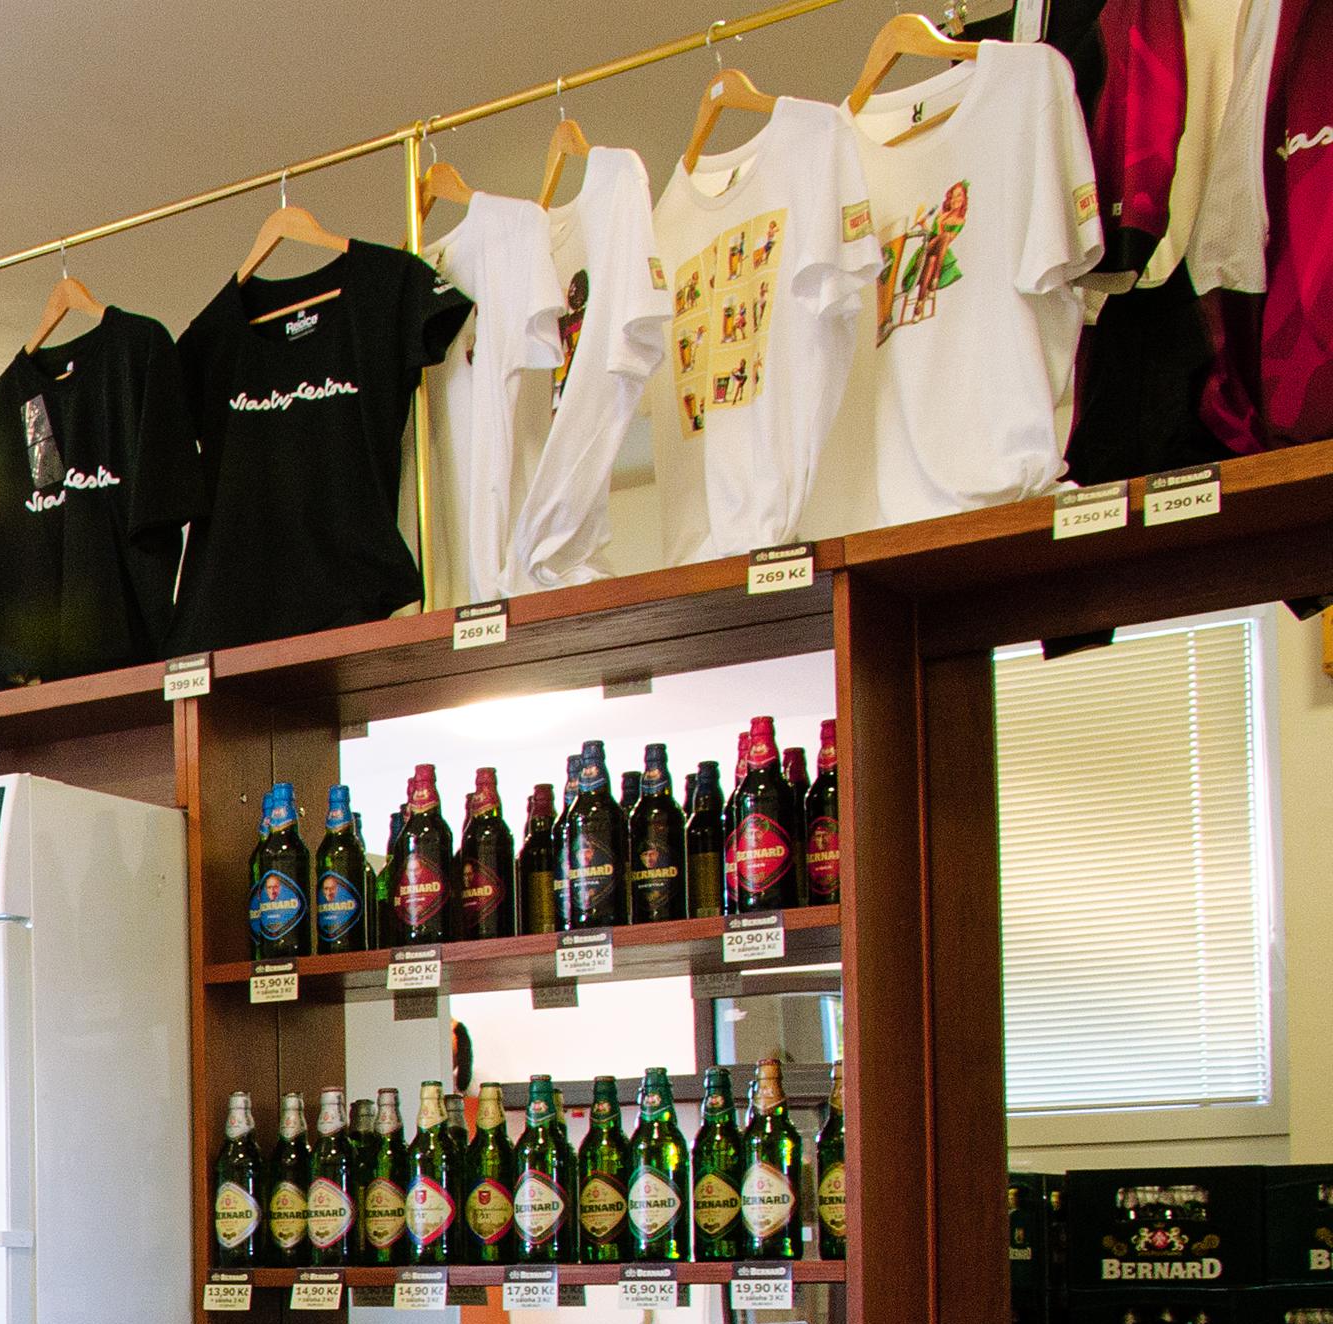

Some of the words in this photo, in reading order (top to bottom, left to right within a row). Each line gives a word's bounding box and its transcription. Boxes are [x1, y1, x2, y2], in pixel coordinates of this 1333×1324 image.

[1152, 502, 1160, 512] 1
[1165, 497, 1193, 511] 290
[1193, 493, 1214, 508] Kč
[1062, 516, 1070, 527] 1
[1074, 511, 1101, 526] 250
[1102, 505, 1122, 520] Kč
[755, 568, 786, 586] 269
[787, 565, 807, 582] Kč
[459, 626, 484, 641] 269
[485, 622, 502, 639] Kč
[169, 679, 192, 692] 399
[192, 675, 207, 690] Kč
[735, 845, 786, 862] BERNARD
[726, 932, 764, 946] 20,90
[765, 930, 782, 944] Kč
[560, 949, 593, 962] 19,90
[595, 947, 611, 960] Kč
[391, 964, 423, 977] 16,90
[423, 962, 440, 974] Kč
[253, 977, 281, 989] 15,90
[282, 974, 296, 986] Kč
[1102, 1258, 1222, 1280] BERNARD
[207, 1287, 235, 1297] 13,90
[236, 1285, 251, 1297] Kč
[295, 1286, 322, 1297] 14,90
[323, 1285, 339, 1296] Kč
[398, 1285, 428, 1297] 14,90
[429, 1285, 444, 1296] Kč
[506, 1284, 539, 1298] 17,90
[539, 1284, 556, 1296] Kč
[621, 1282, 656, 1295] 16,90
[656, 1282, 675, 1295] Kč
[735, 1282, 770, 1296] 19,90
[770, 1281, 789, 1294] Kč
